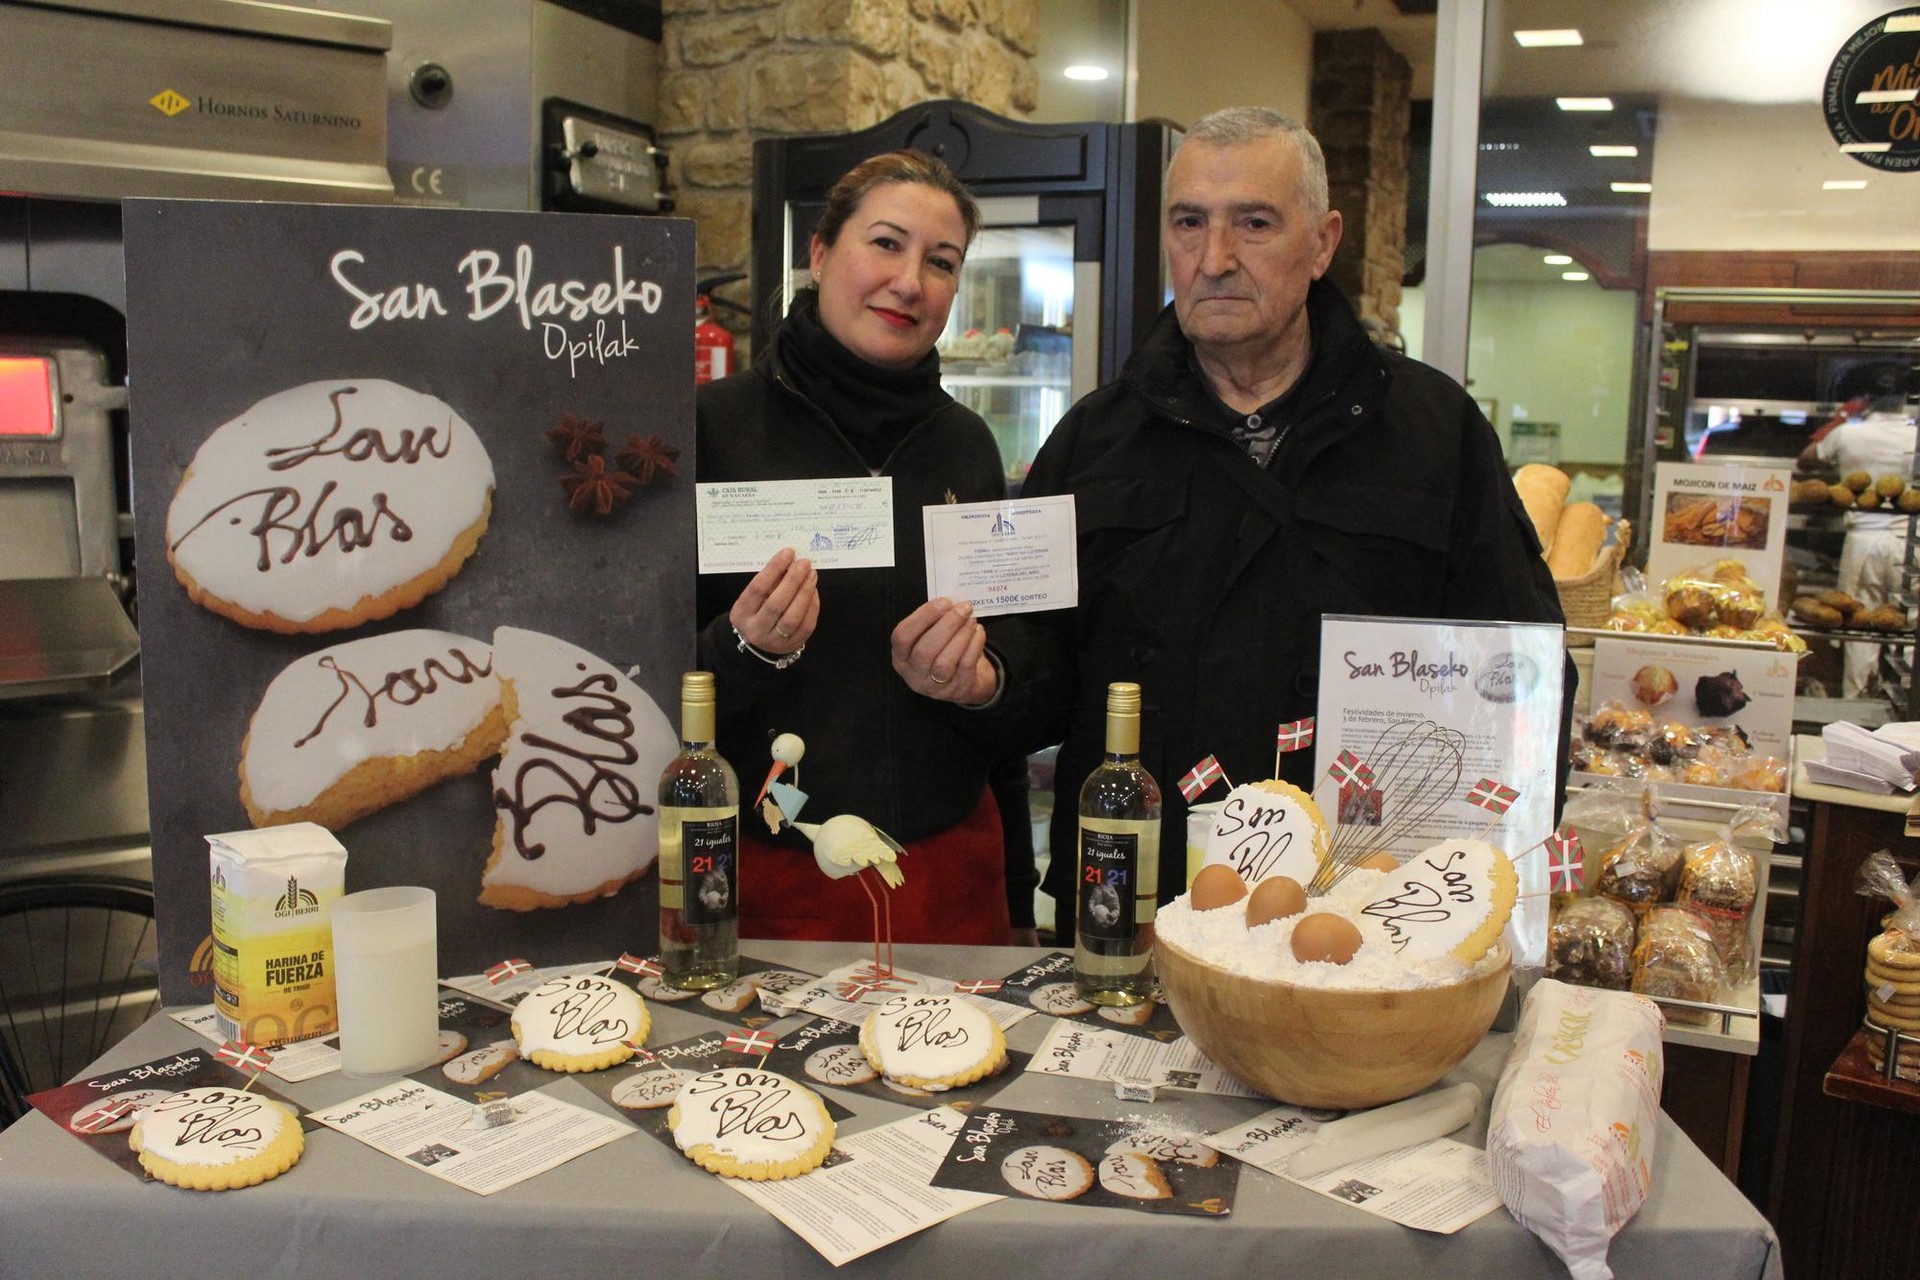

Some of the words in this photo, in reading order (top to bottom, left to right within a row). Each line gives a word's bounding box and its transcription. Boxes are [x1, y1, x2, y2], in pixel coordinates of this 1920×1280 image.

[199, 95, 268, 119] HORNOS
[273, 103, 361, 129] SATURNINO
[411, 167, 443, 195] CE
[331, 249, 447, 330] San
[458, 245, 663, 329] Blaseko
[542, 319, 640, 378] Opilak
[265, 386, 453, 470] San
[1673, 479, 1716, 489] MOJICON
[1718, 482, 1728, 490] DE
[1732, 483, 1757, 491] MAIZ
[172, 480, 413, 572] Blas
[996, 595, 1019, 603] 1500€
[1020, 593, 1048, 601] SORTEO
[1343, 650, 1385, 679] San
[1389, 650, 1469, 682] Blaseko
[294, 648, 494, 748] San
[1419, 678, 1458, 699] Opilak
[1343, 708, 1384, 717] Festividades
[694, 838, 704, 847] 21
[706, 833, 731, 850] iguales
[1087, 847, 1095, 857] 21
[1096, 849, 1126, 861] iguales
[692, 856, 713, 873] 21
[1229, 832, 1293, 882] Bl
[1085, 866, 1102, 884] 21
[1107, 869, 1127, 886] 21
[274, 910, 291, 919] OGI
[295, 906, 319, 917] BERRI
[266, 952, 307, 970] HARINA
[311, 950, 325, 964] DE
[266, 962, 324, 988] FUERZA
[536, 974, 611, 997] San
[283, 986, 292, 994] DE
[550, 991, 629, 1045] Blas
[880, 996, 950, 1016] San
[895, 1008, 968, 1052] Blas
[1052, 1031, 1083, 1058] Blaseko
[88, 1077, 133, 1091] San
[129, 1056, 200, 1080] Blaseko
[690, 1071, 781, 1095] San
[154, 1091, 253, 1113] San
[323, 1110, 366, 1124] San
[360, 1087, 425, 1111] Blaseko
[710, 1088, 806, 1141] Blas
[175, 1104, 263, 1149] Blas
[919, 1113, 946, 1131] San
[966, 1112, 1001, 1144] Blaseko
[1246, 1116, 1303, 1143] Blaseko
[956, 1144, 987, 1162] San
[1006, 1150, 1039, 1180] San
